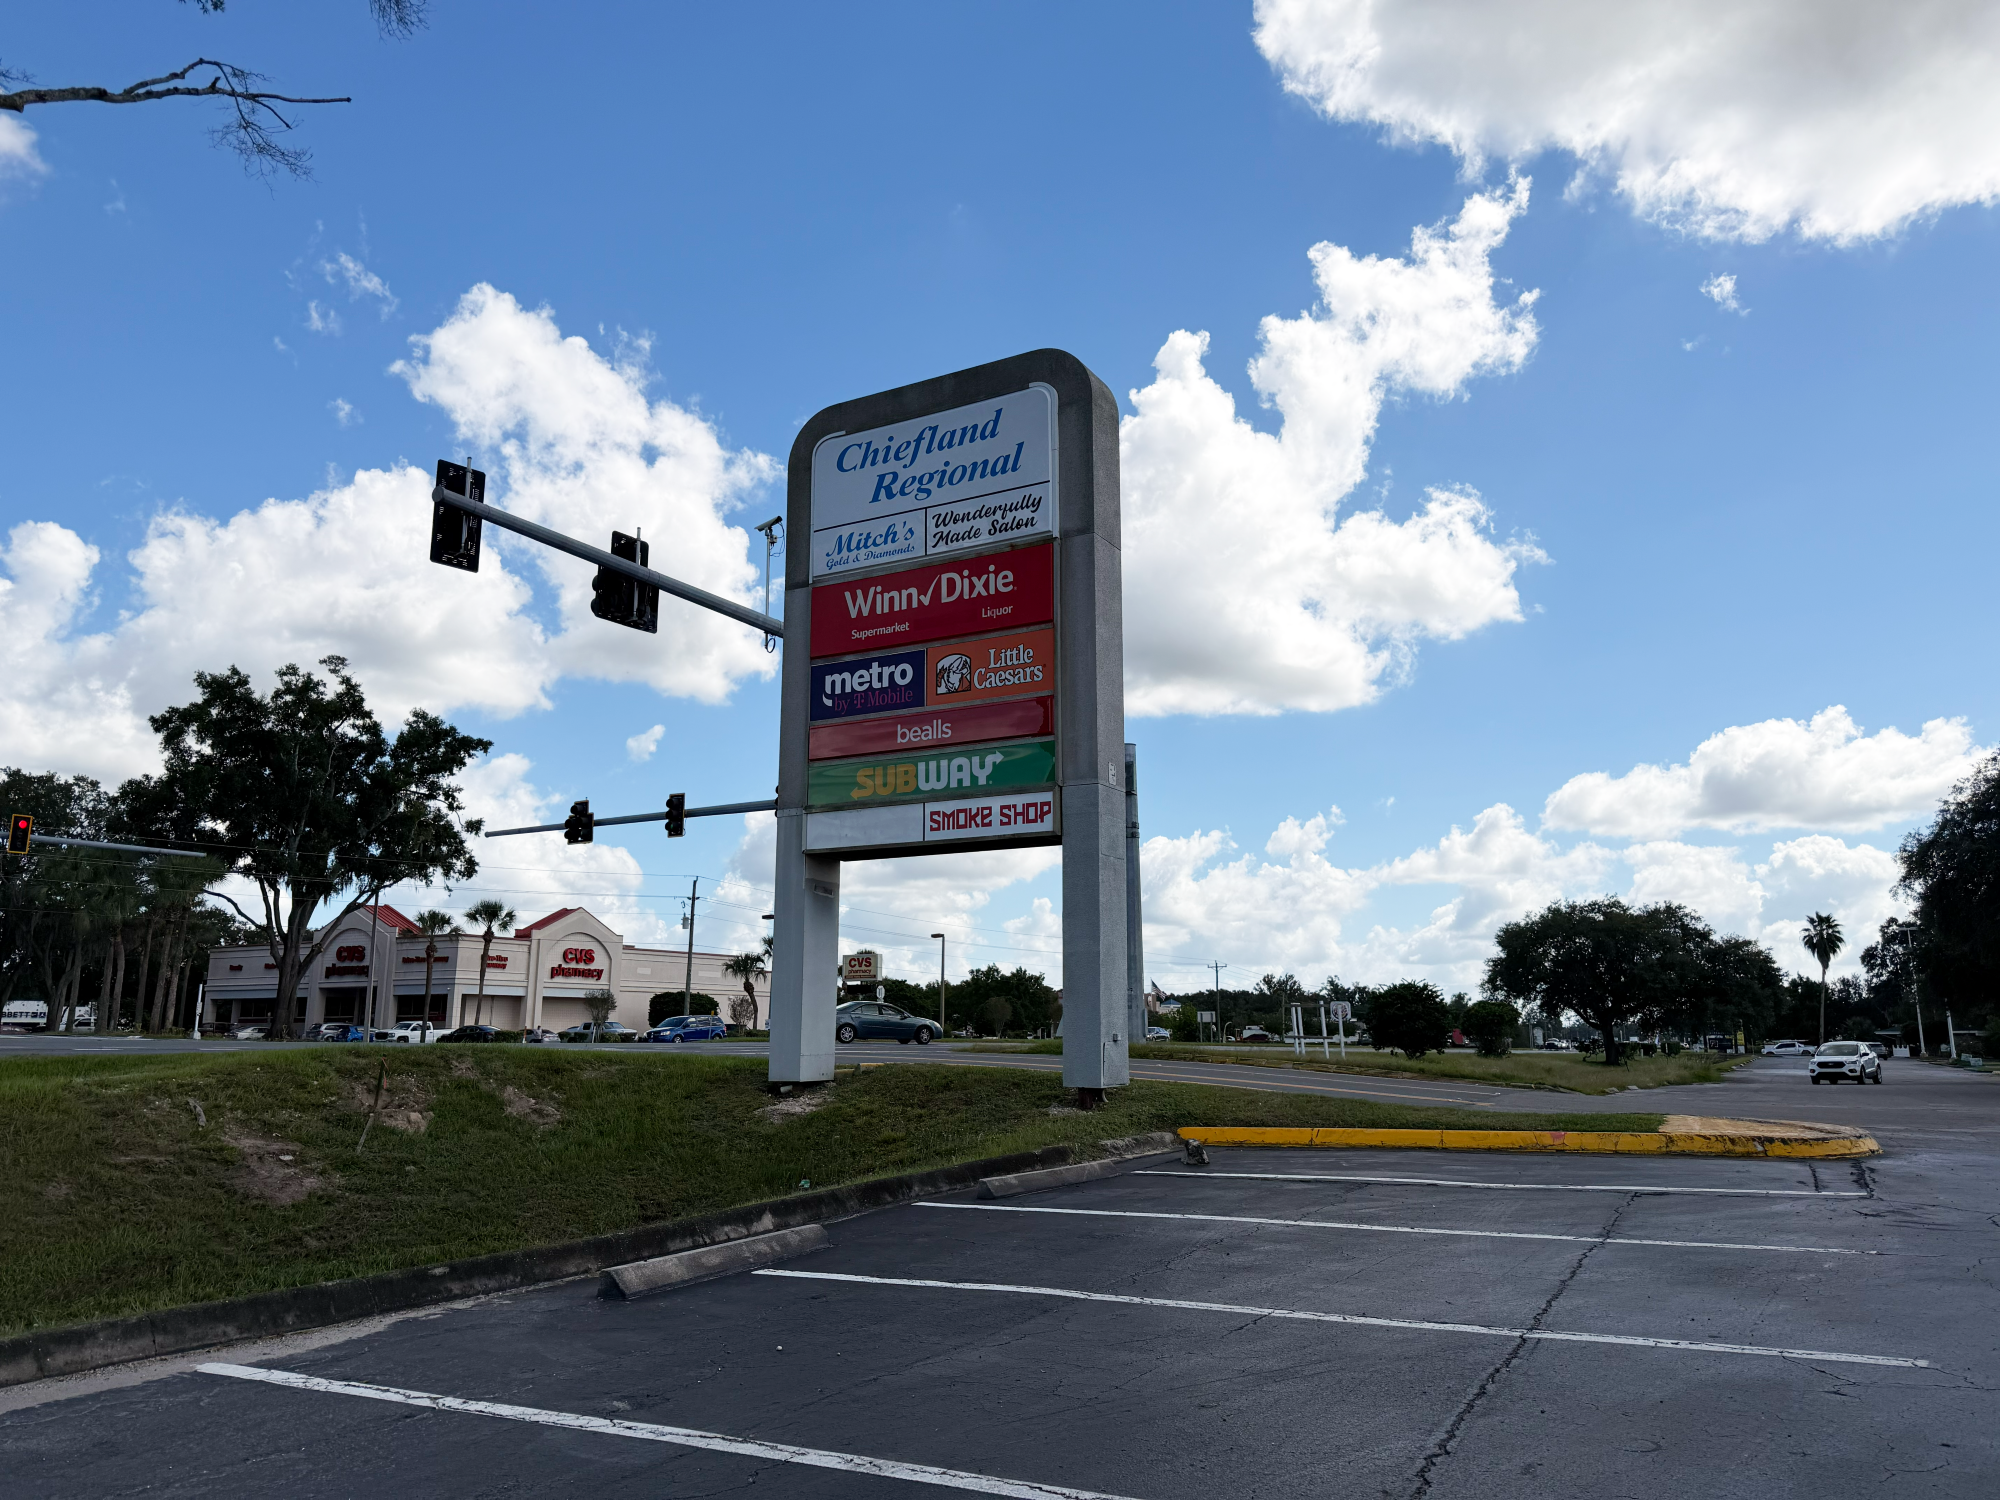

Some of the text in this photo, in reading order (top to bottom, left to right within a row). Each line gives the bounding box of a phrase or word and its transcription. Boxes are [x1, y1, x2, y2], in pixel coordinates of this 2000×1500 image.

[836, 408, 1003, 473] Chiefland
[869, 441, 1025, 504] Regional
[932, 493, 1043, 530] Wonderfully
[825, 521, 915, 558] Mitch's
[932, 515, 1038, 549] Made Salon
[826, 545, 915, 571] Gold & Diamonds
[844, 564, 1014, 619] Winn Dixie
[982, 605, 1013, 619] Liquor
[851, 621, 910, 640] Supermarket
[988, 644, 1033, 669] Little
[822, 661, 913, 707] metro
[973, 664, 1044, 690] Caesars
[834, 696, 850, 715] by
[897, 719, 952, 744] bealls
[850, 750, 1005, 801] SUBWAY
[929, 800, 1052, 832] SMOKE SHOP
[336, 945, 365, 962] CVS
[563, 948, 595, 965] CVS
[848, 957, 872, 968] CVS
[551, 964, 604, 981] pharmacy
